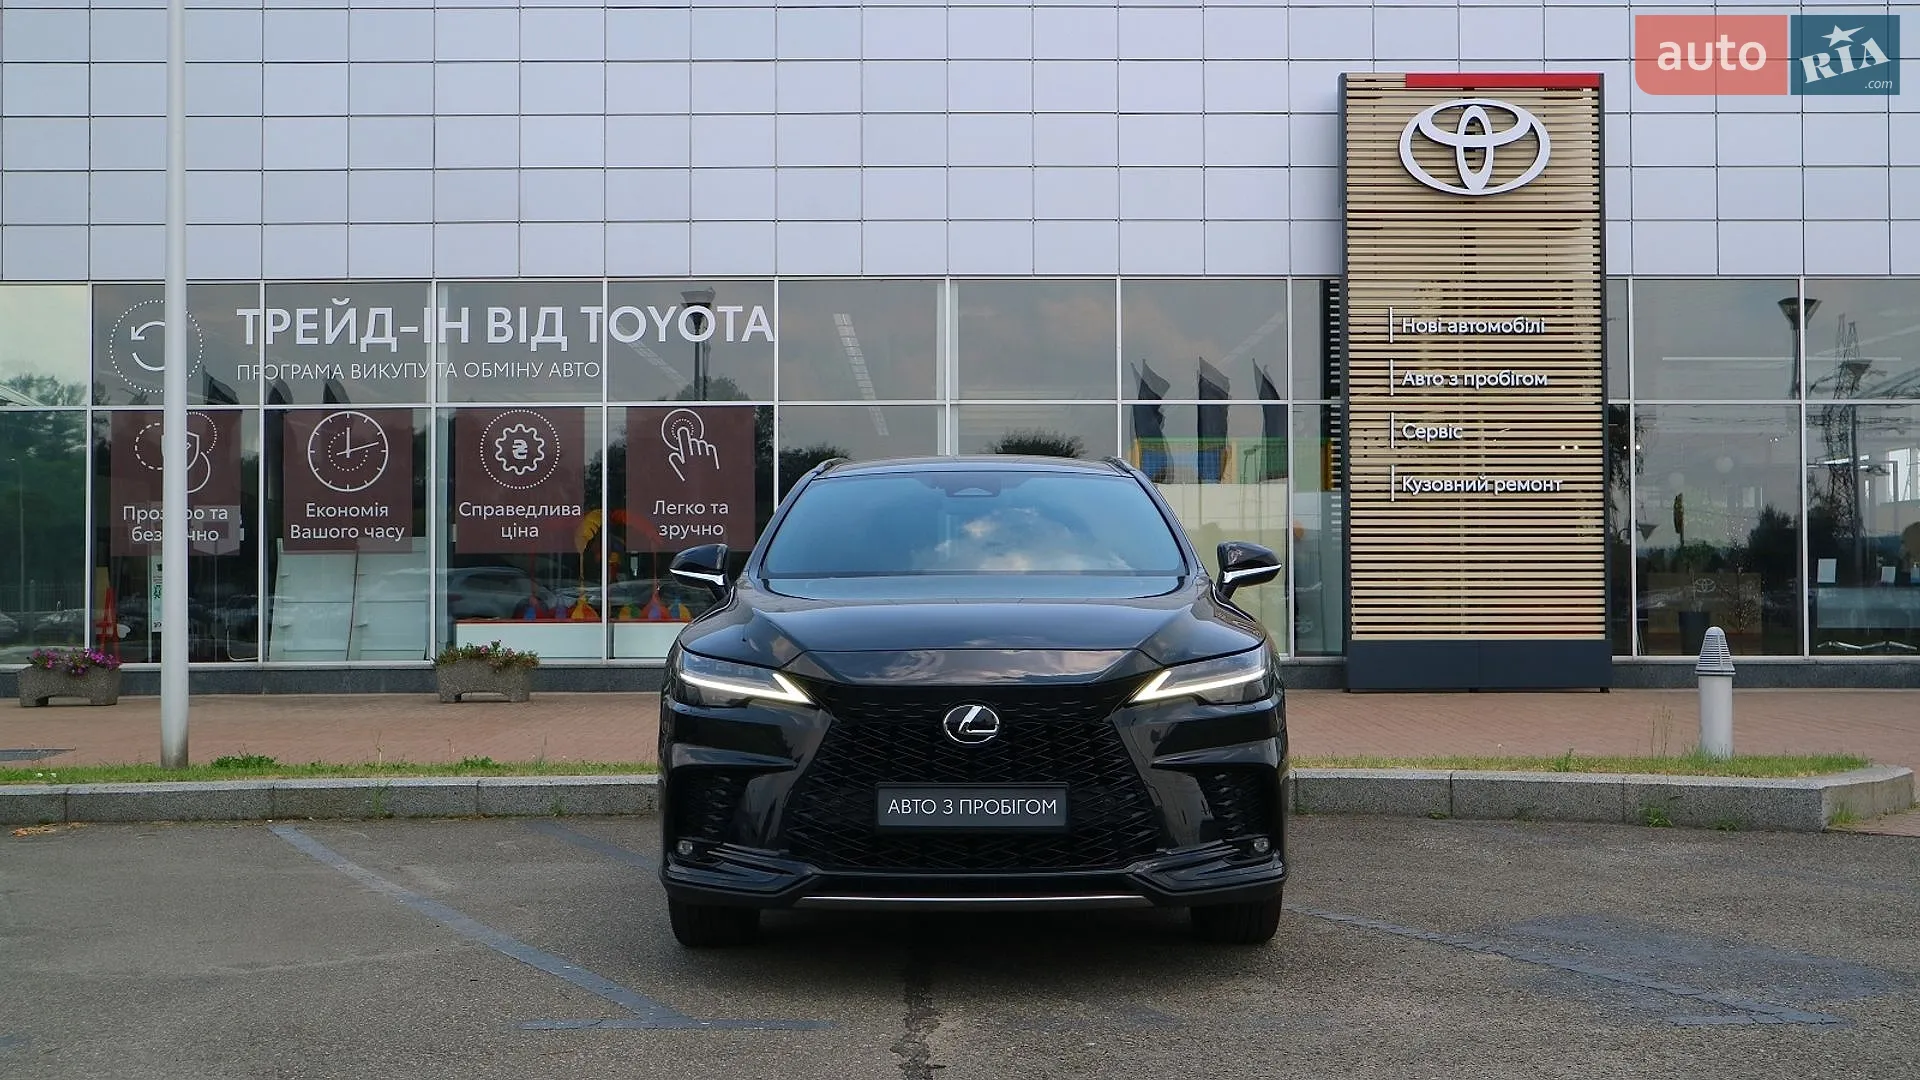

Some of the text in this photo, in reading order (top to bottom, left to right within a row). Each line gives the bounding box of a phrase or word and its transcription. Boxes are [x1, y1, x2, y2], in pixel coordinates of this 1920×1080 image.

[236, 297, 775, 353] ТРЕЙД-ІН ВІД TOYOTA
[1401, 316, 1545, 334] Нові автомобілі
[237, 361, 600, 381] ПРОГРАМА ВИКУПУ ТА ОБМІНУ АВТО
[1402, 370, 1548, 390] Авто з пробігом
[1402, 423, 1463, 443] Сервіс
[1402, 475, 1563, 496] Кузовний ремонт
[209, 508, 228, 520] та
[305, 502, 389, 518] Економія
[458, 501, 581, 520] Справедлива
[653, 500, 729, 515] Легко та
[290, 525, 406, 542] Вашого часу
[501, 522, 539, 540] ціна
[659, 525, 724, 540] зручно
[887, 799, 937, 815] АВТО
[959, 799, 1057, 815] ПРОБІГОМ
